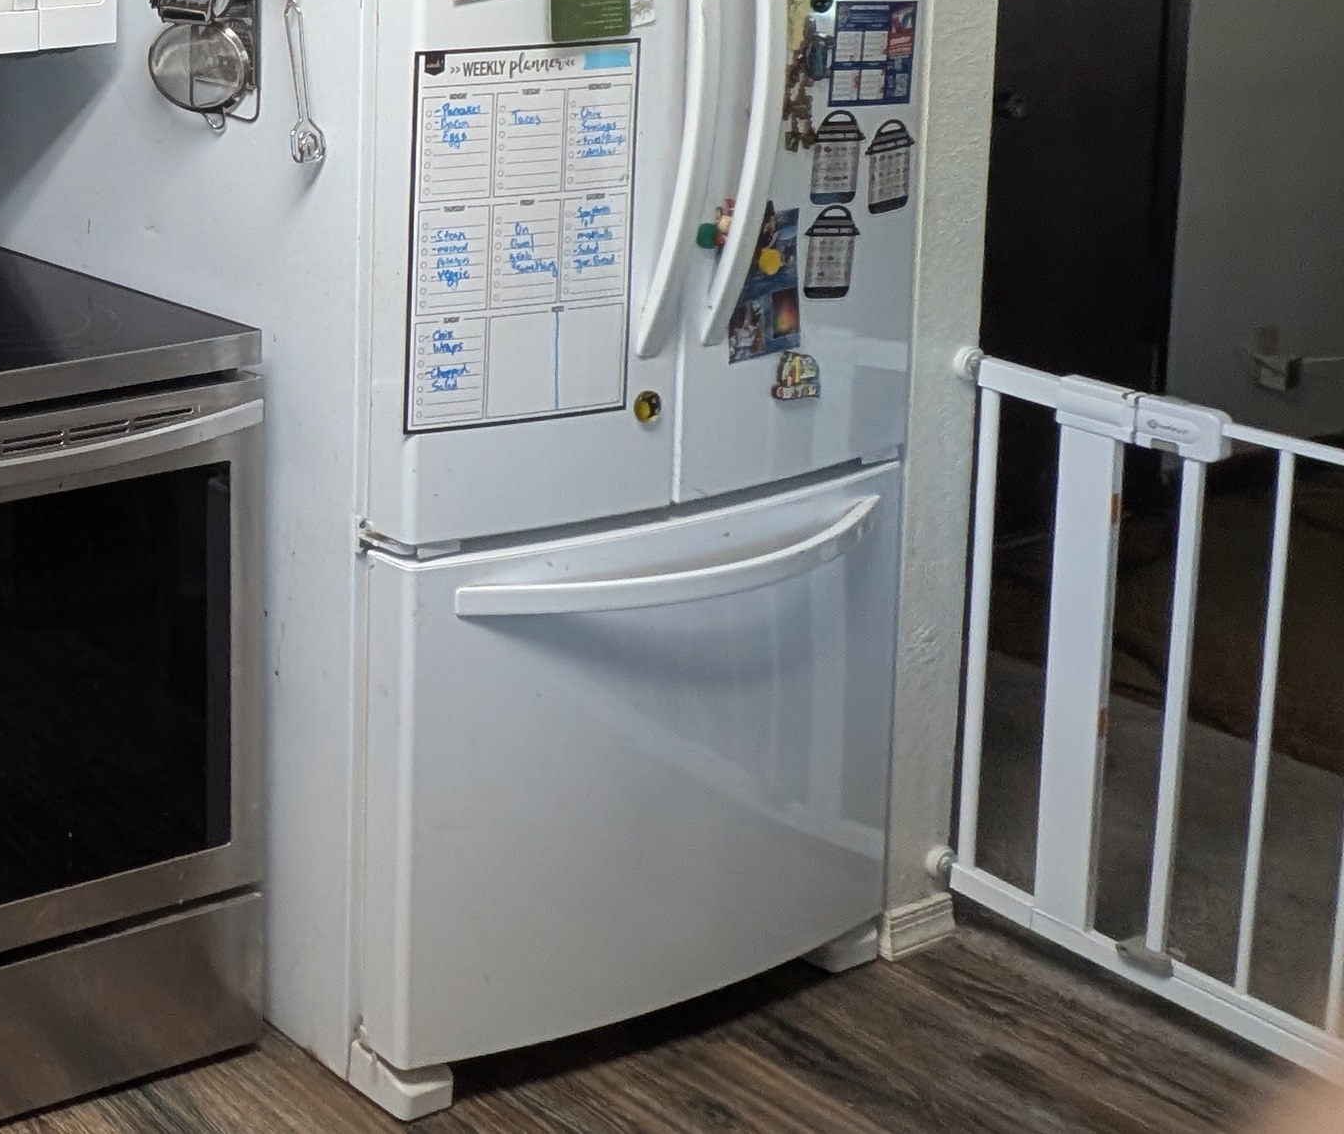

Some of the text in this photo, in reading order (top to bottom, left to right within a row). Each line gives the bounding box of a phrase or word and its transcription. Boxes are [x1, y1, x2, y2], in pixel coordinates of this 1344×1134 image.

[462, 52, 563, 79] WEEKLY planner
[511, 109, 542, 126] Tacos
